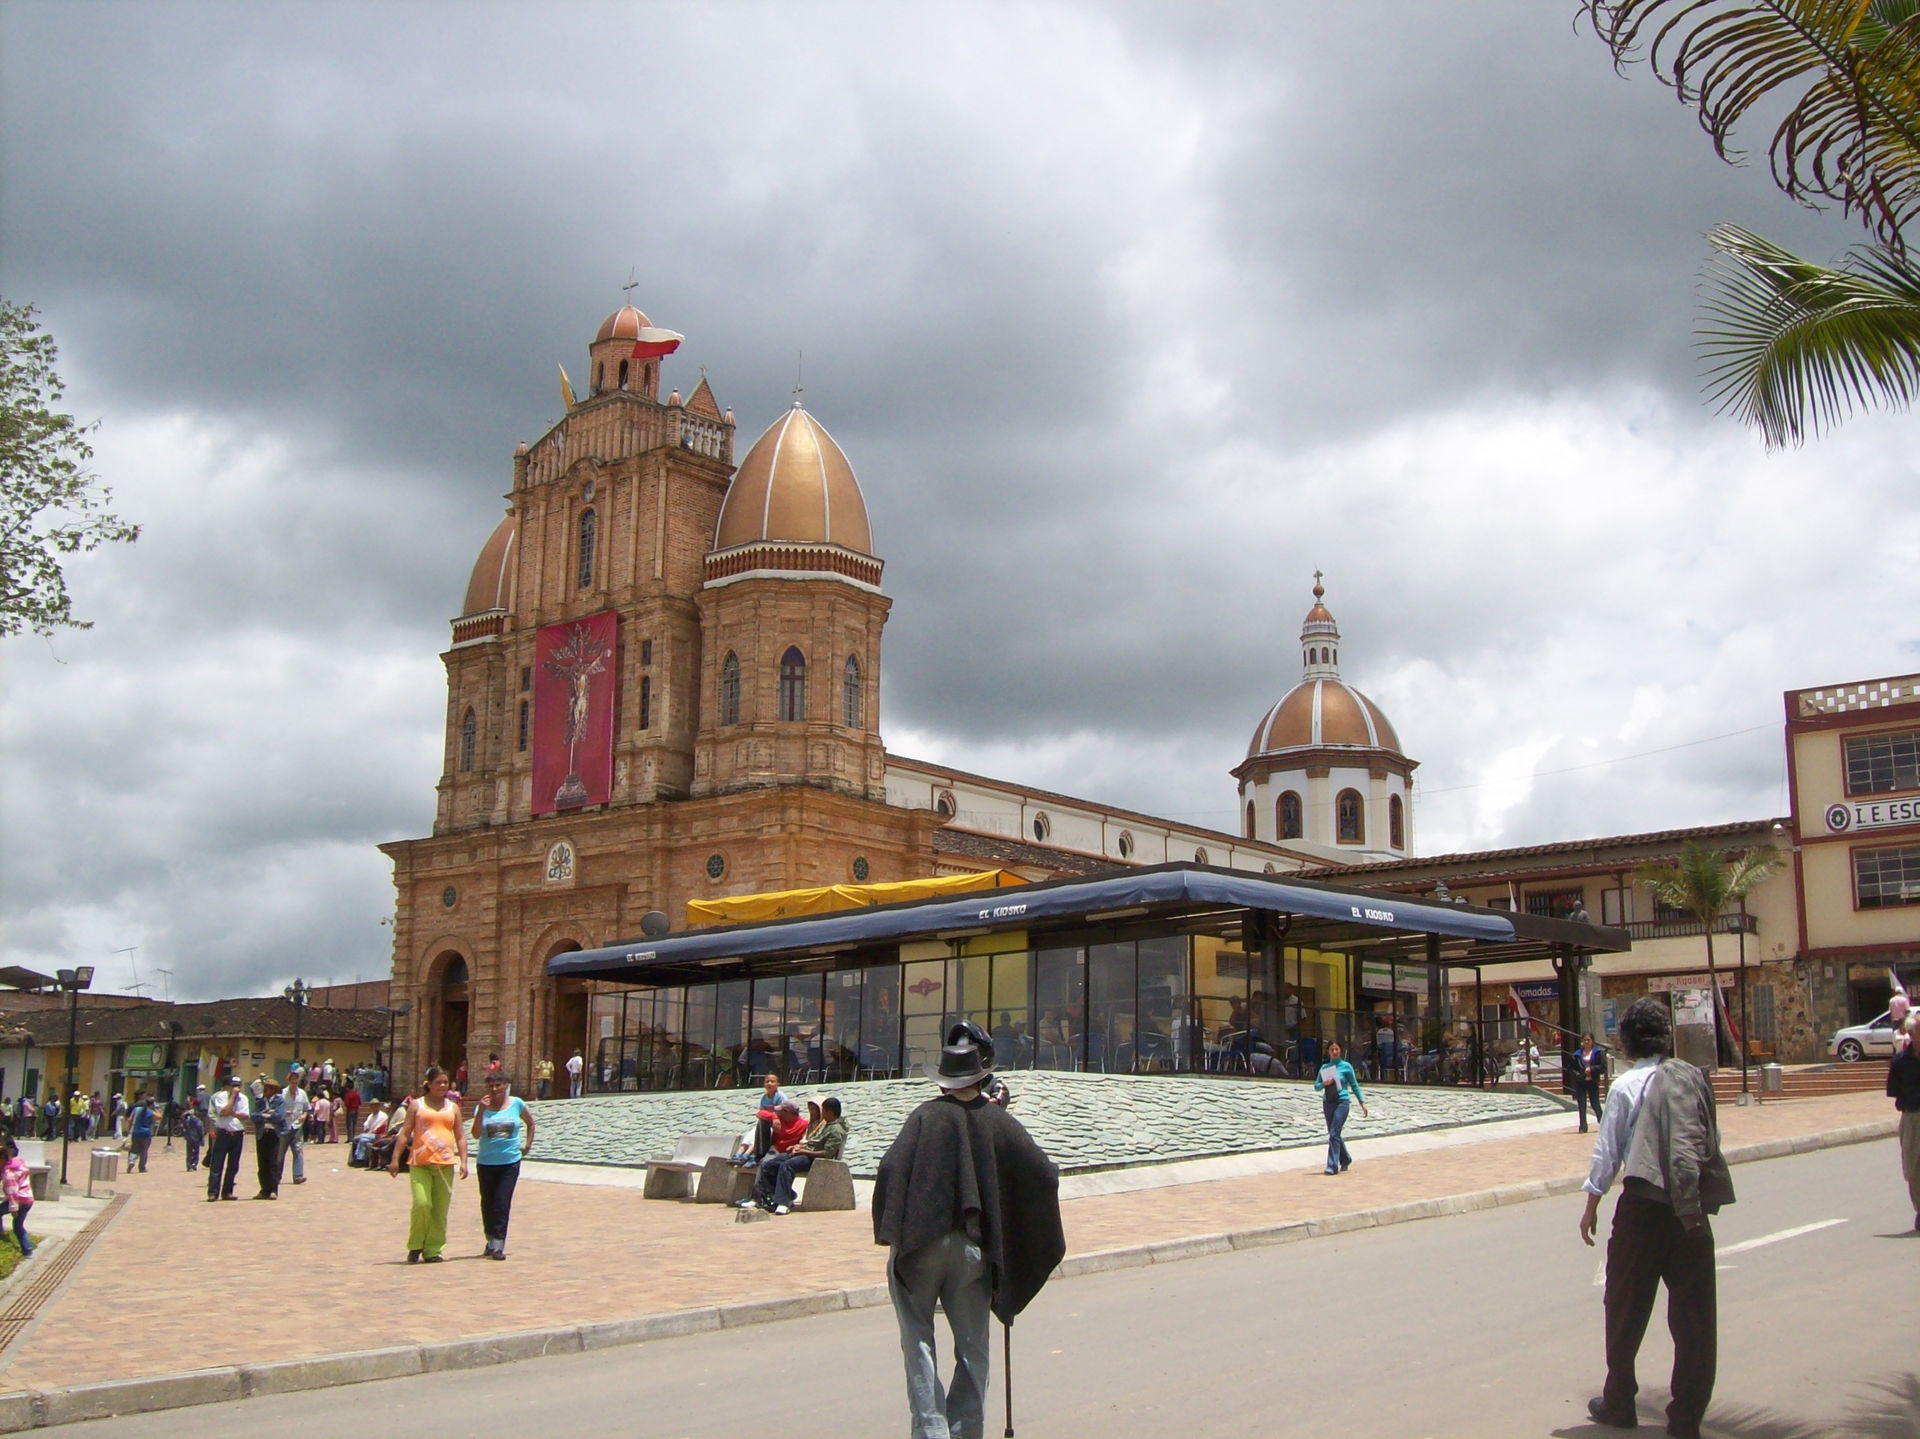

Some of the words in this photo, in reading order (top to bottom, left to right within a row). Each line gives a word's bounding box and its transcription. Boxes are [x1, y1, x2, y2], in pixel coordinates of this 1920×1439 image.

[1855, 808, 1867, 824] I.
[1871, 806, 1885, 823] E.
[979, 909, 990, 920] EL
[993, 904, 1027, 918] KIOSKO
[1351, 906, 1362, 918] EL
[1365, 908, 1394, 922] KIOSKO
